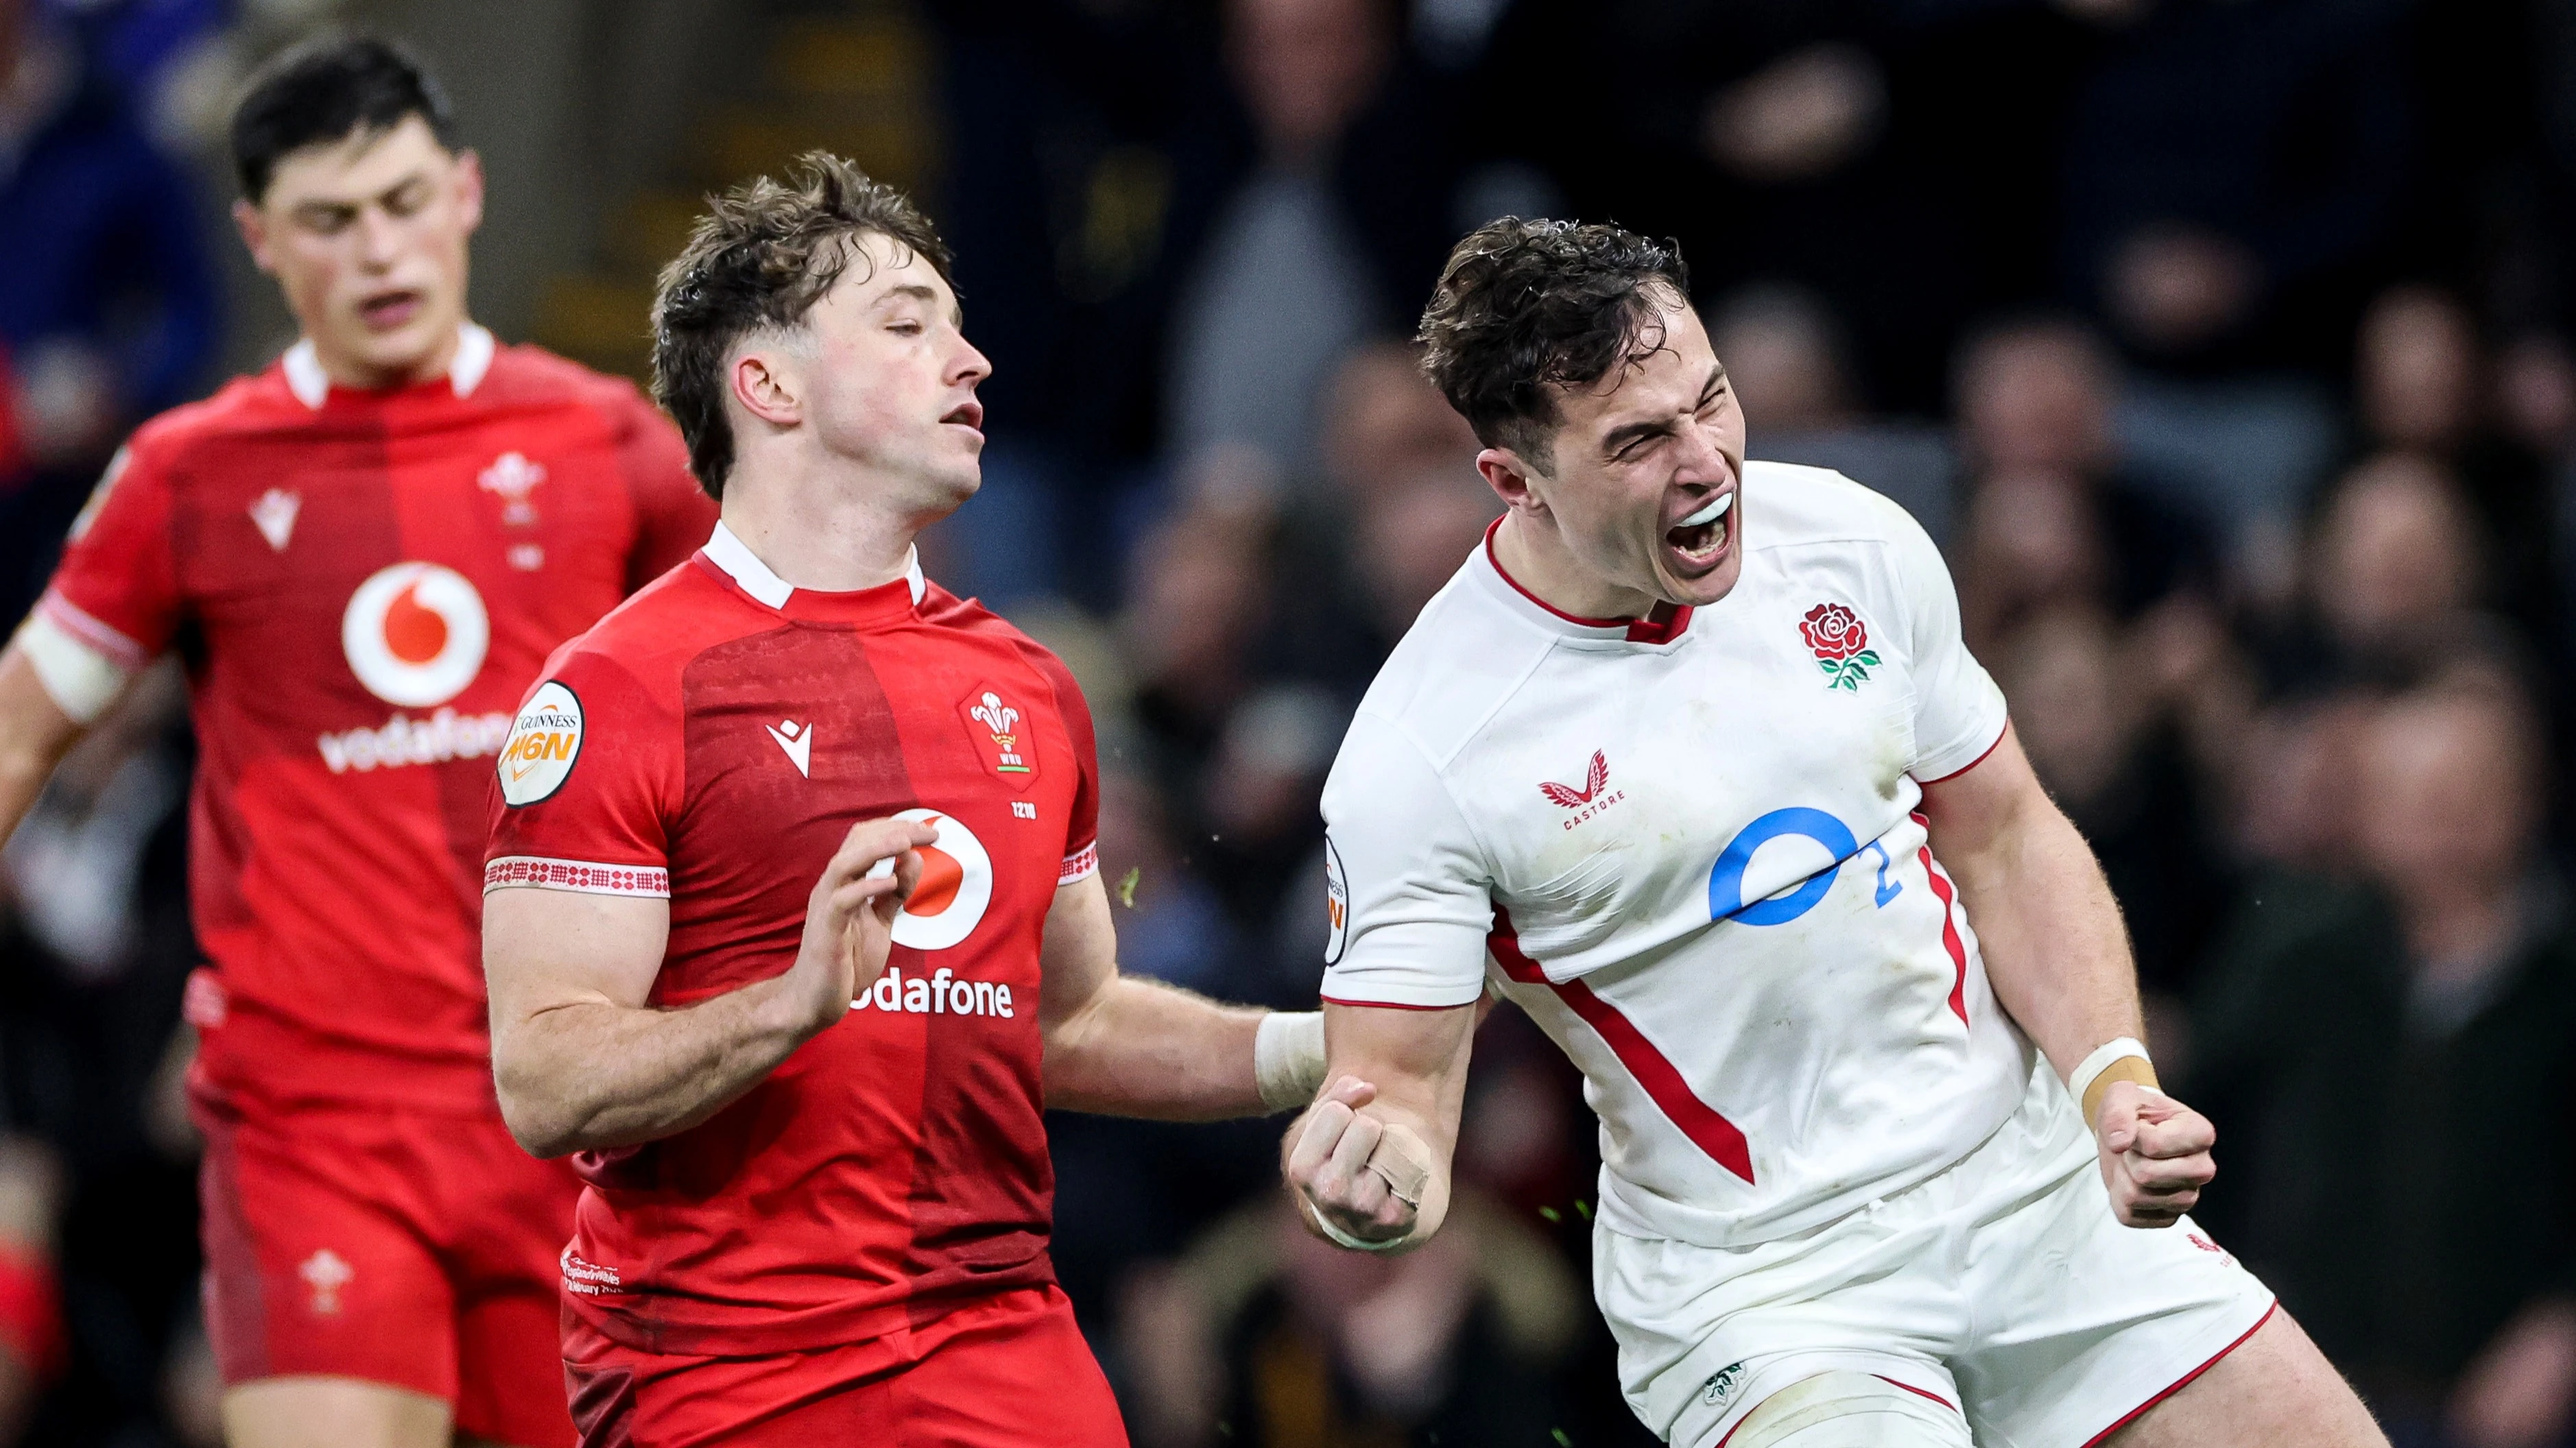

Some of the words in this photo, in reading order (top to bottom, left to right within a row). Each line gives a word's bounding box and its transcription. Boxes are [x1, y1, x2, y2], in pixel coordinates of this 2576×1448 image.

[521, 714, 577, 730] GUINNESS
[318, 708, 511, 773] vodafon
[999, 753, 1023, 766] WRU
[1011, 801, 1037, 819] 1210
[1564, 790, 1625, 830] CASTORE
[849, 967, 1014, 1018] dafone
